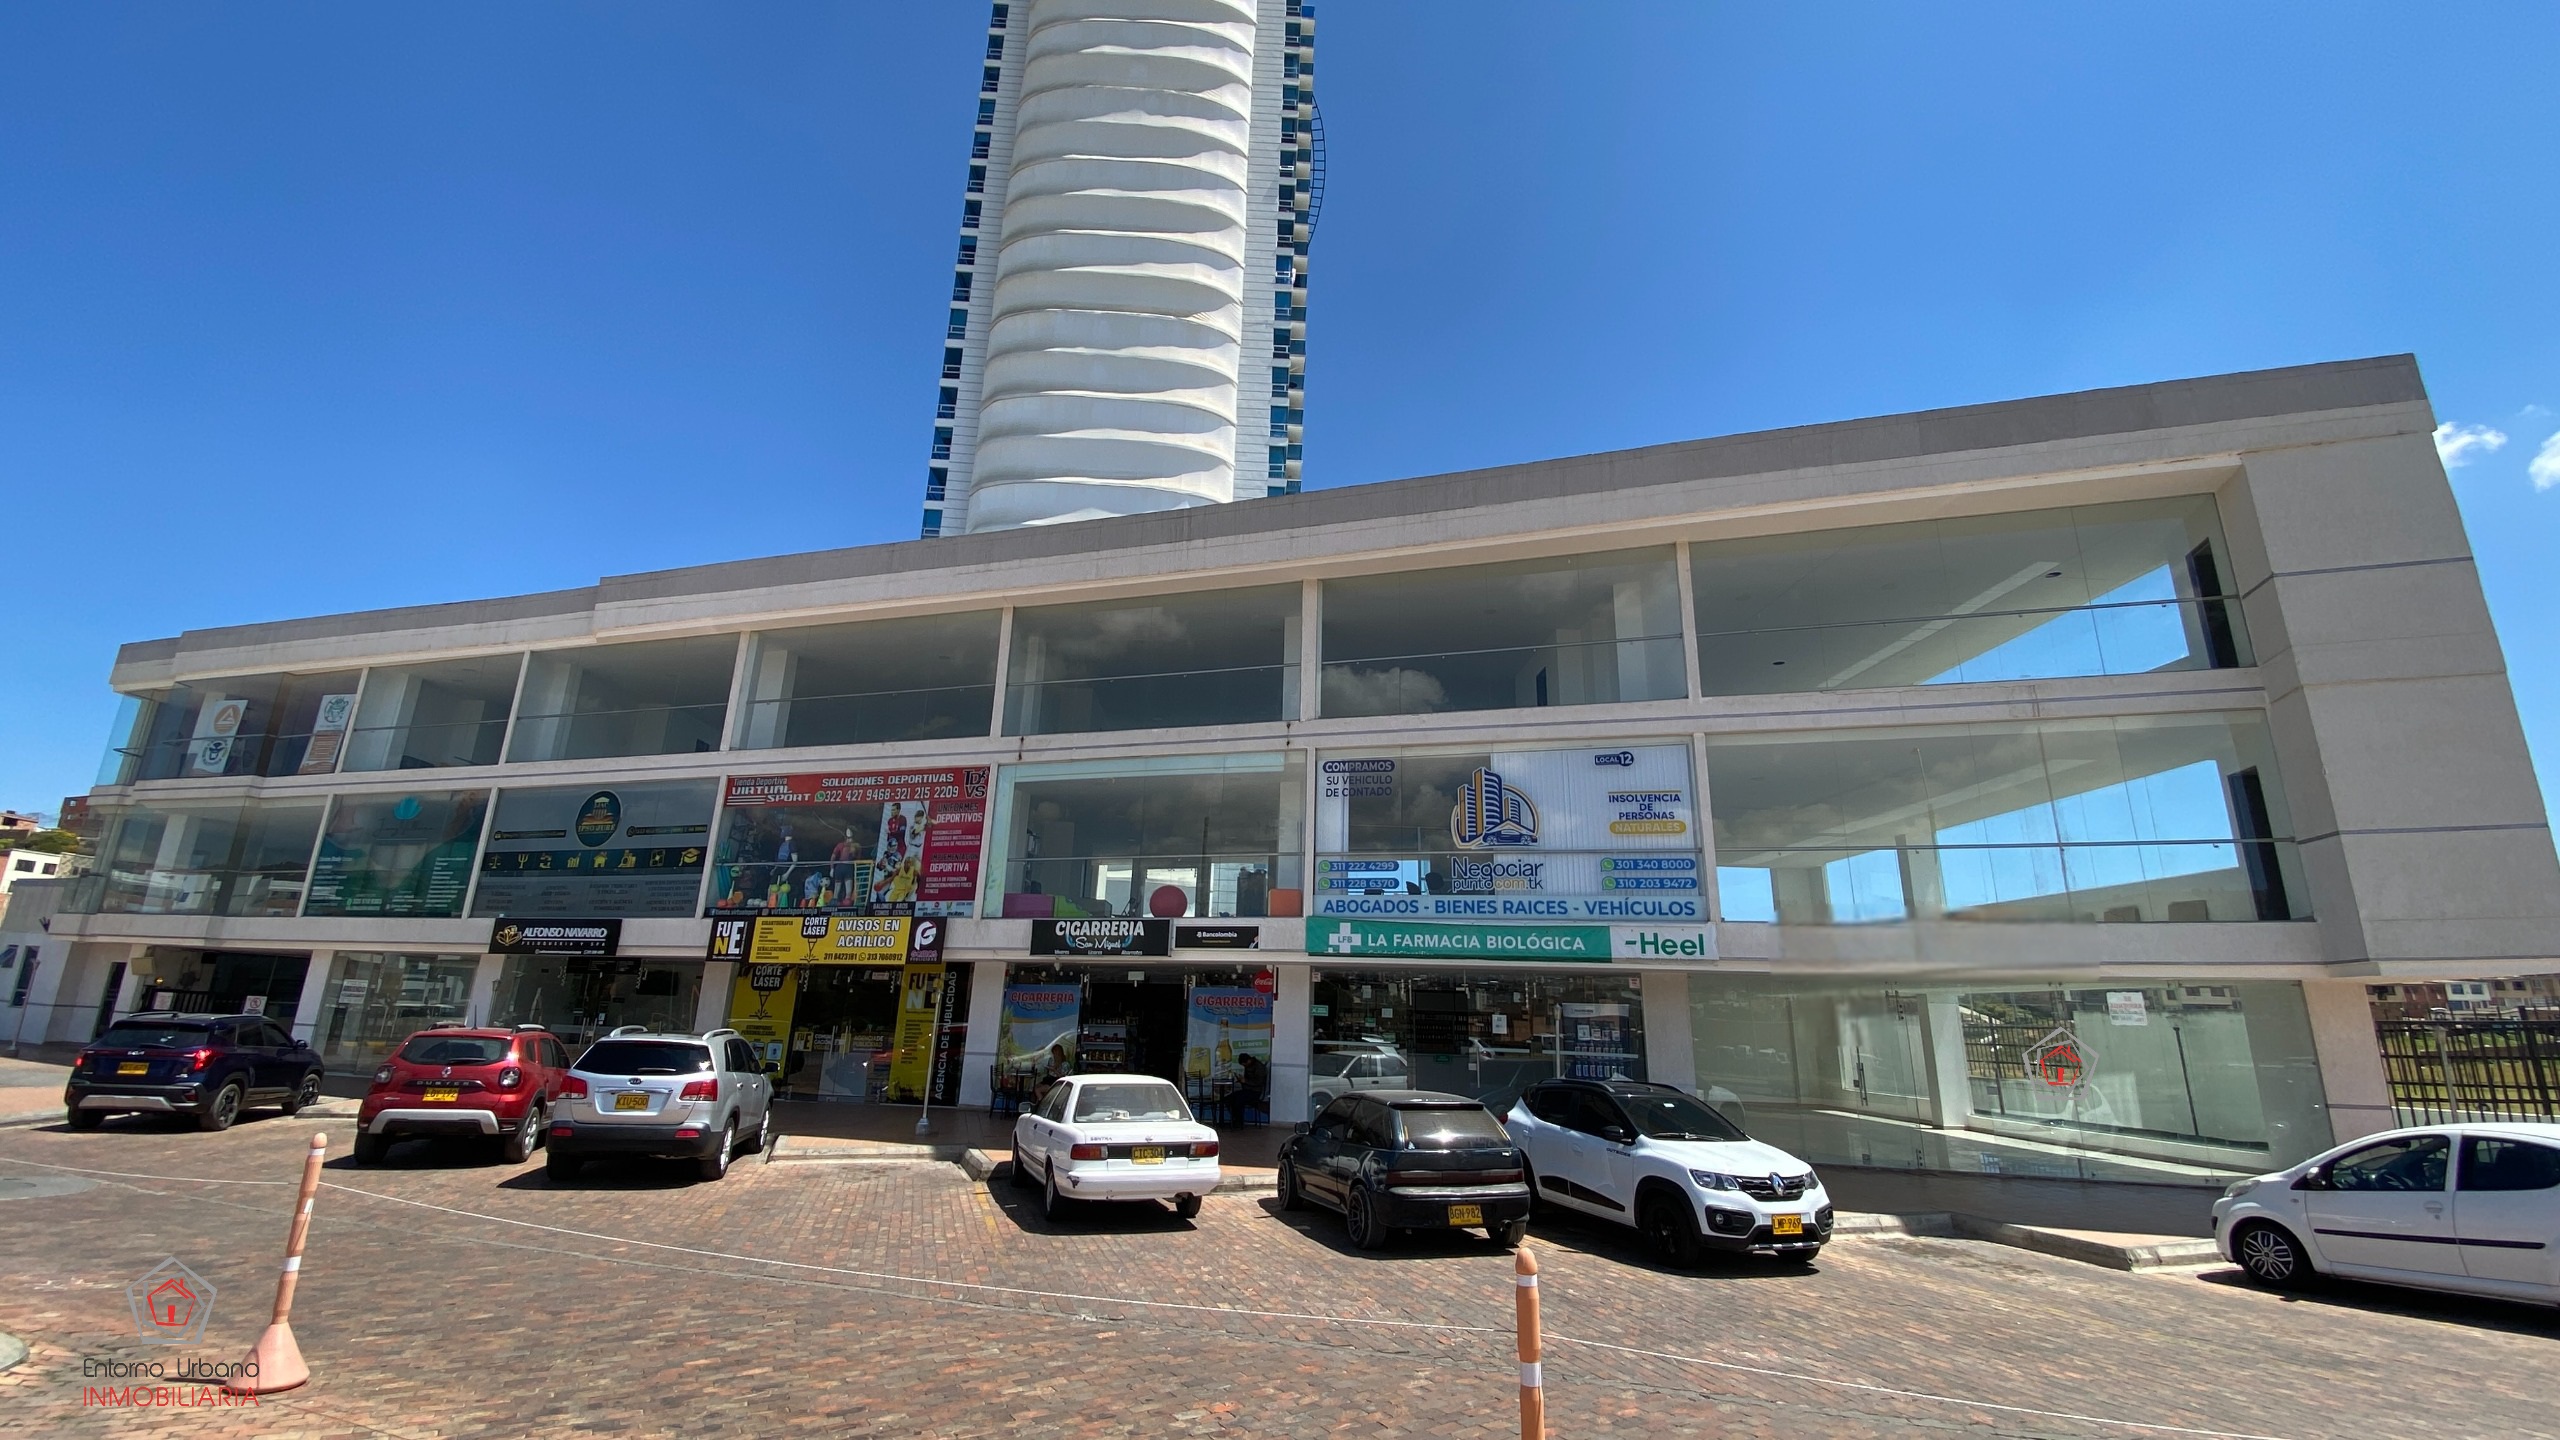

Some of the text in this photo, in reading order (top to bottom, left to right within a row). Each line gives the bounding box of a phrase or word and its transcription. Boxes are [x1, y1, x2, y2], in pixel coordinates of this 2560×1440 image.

[1619, 753, 1632, 764] 12
[1325, 761, 1393, 772] COMPRAMOS
[735, 777, 787, 786] Tienda Deportiva
[822, 773, 954, 787] SOLUCIONES DEPORTIVAS
[1326, 774, 1393, 785] SU VEHICULO
[732, 785, 792, 795] VIRTUAL
[825, 790, 842, 802] 322
[846, 790, 863, 801] 427
[914, 786, 930, 798] 215
[934, 785, 959, 798] 2209
[1325, 786, 1392, 797] DE CONTADO
[767, 794, 812, 802] SPORT
[1608, 794, 1681, 803] INSOLVENCIA
[1640, 803, 1653, 811] DE
[936, 813, 983, 823] DEPORTIVOS
[1618, 811, 1675, 820] PERSONAS
[1615, 823, 1680, 832] NATURALES
[930, 863, 969, 872] DEPORTIVA
[1331, 861, 1394, 871] 311 222 4299
[1453, 858, 1543, 881] Negociar
[1616, 860, 1691, 869] 301 340 8000
[1331, 879, 1395, 888] 311 228 6370
[1618, 880, 1693, 888] 310 203 9472
[1324, 899, 1419, 914] ABOGADOS
[1435, 900, 1497, 914] BIENES
[1503, 900, 1568, 915] RAICES
[1584, 897, 1696, 916] VEHÍCULOS
[805, 917, 828, 926] CORTE
[837, 919, 900, 931] AVISOS EN
[523, 927, 607, 938] ALFONSO NAVARRO
[803, 926, 826, 935] LASER
[1055, 920, 1145, 936] CIGARRERIA
[837, 931, 895, 947] ACRÍLICO
[1202, 930, 1237, 938] Bancolombia
[1368, 932, 1585, 951] LA FARMACIA BIOLÓGICA
[755, 966, 782, 975] CORTE
[753, 977, 780, 987] LASER
[934, 971, 957, 1100] AGENCIA DE PUBLICIDAD
